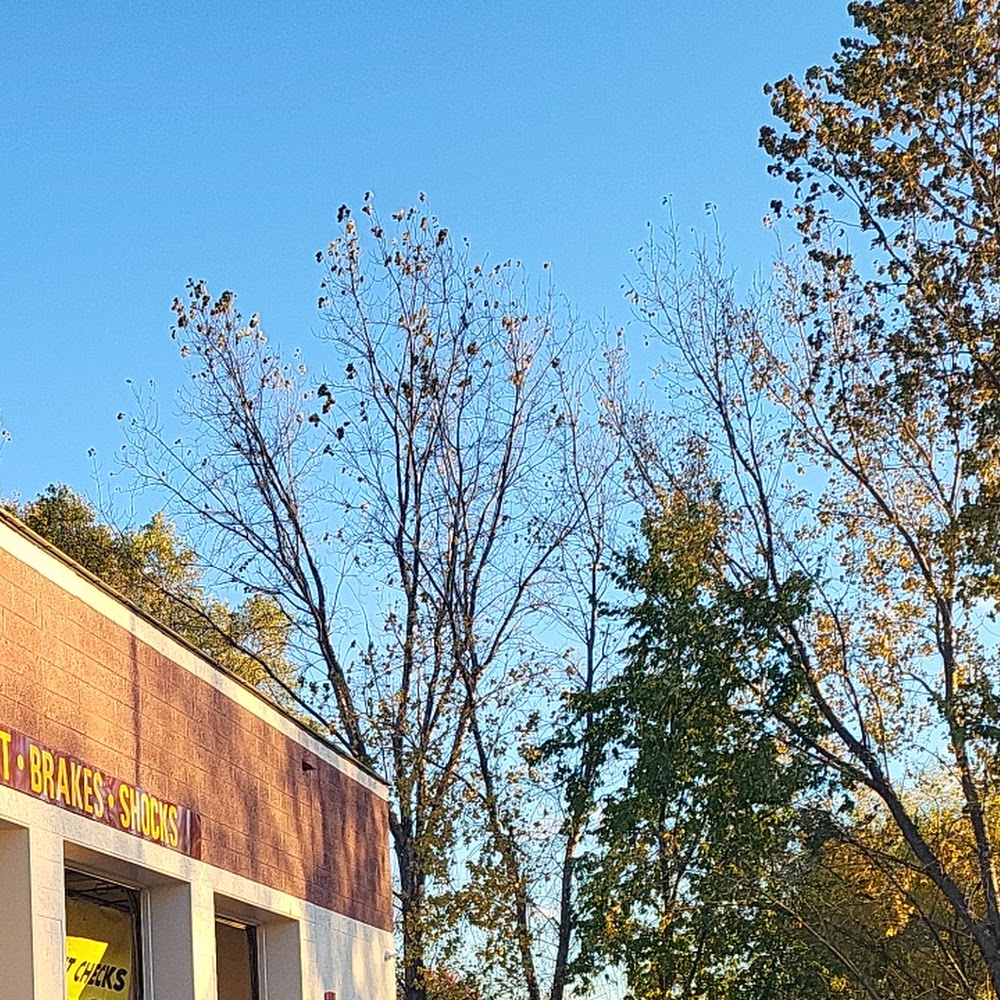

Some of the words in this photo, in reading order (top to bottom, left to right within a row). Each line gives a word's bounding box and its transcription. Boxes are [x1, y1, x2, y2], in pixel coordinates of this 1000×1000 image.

[28, 743, 105, 819] BRAKES
[118, 784, 180, 848] SHOCKS
[74, 961, 128, 992] CHECKS
